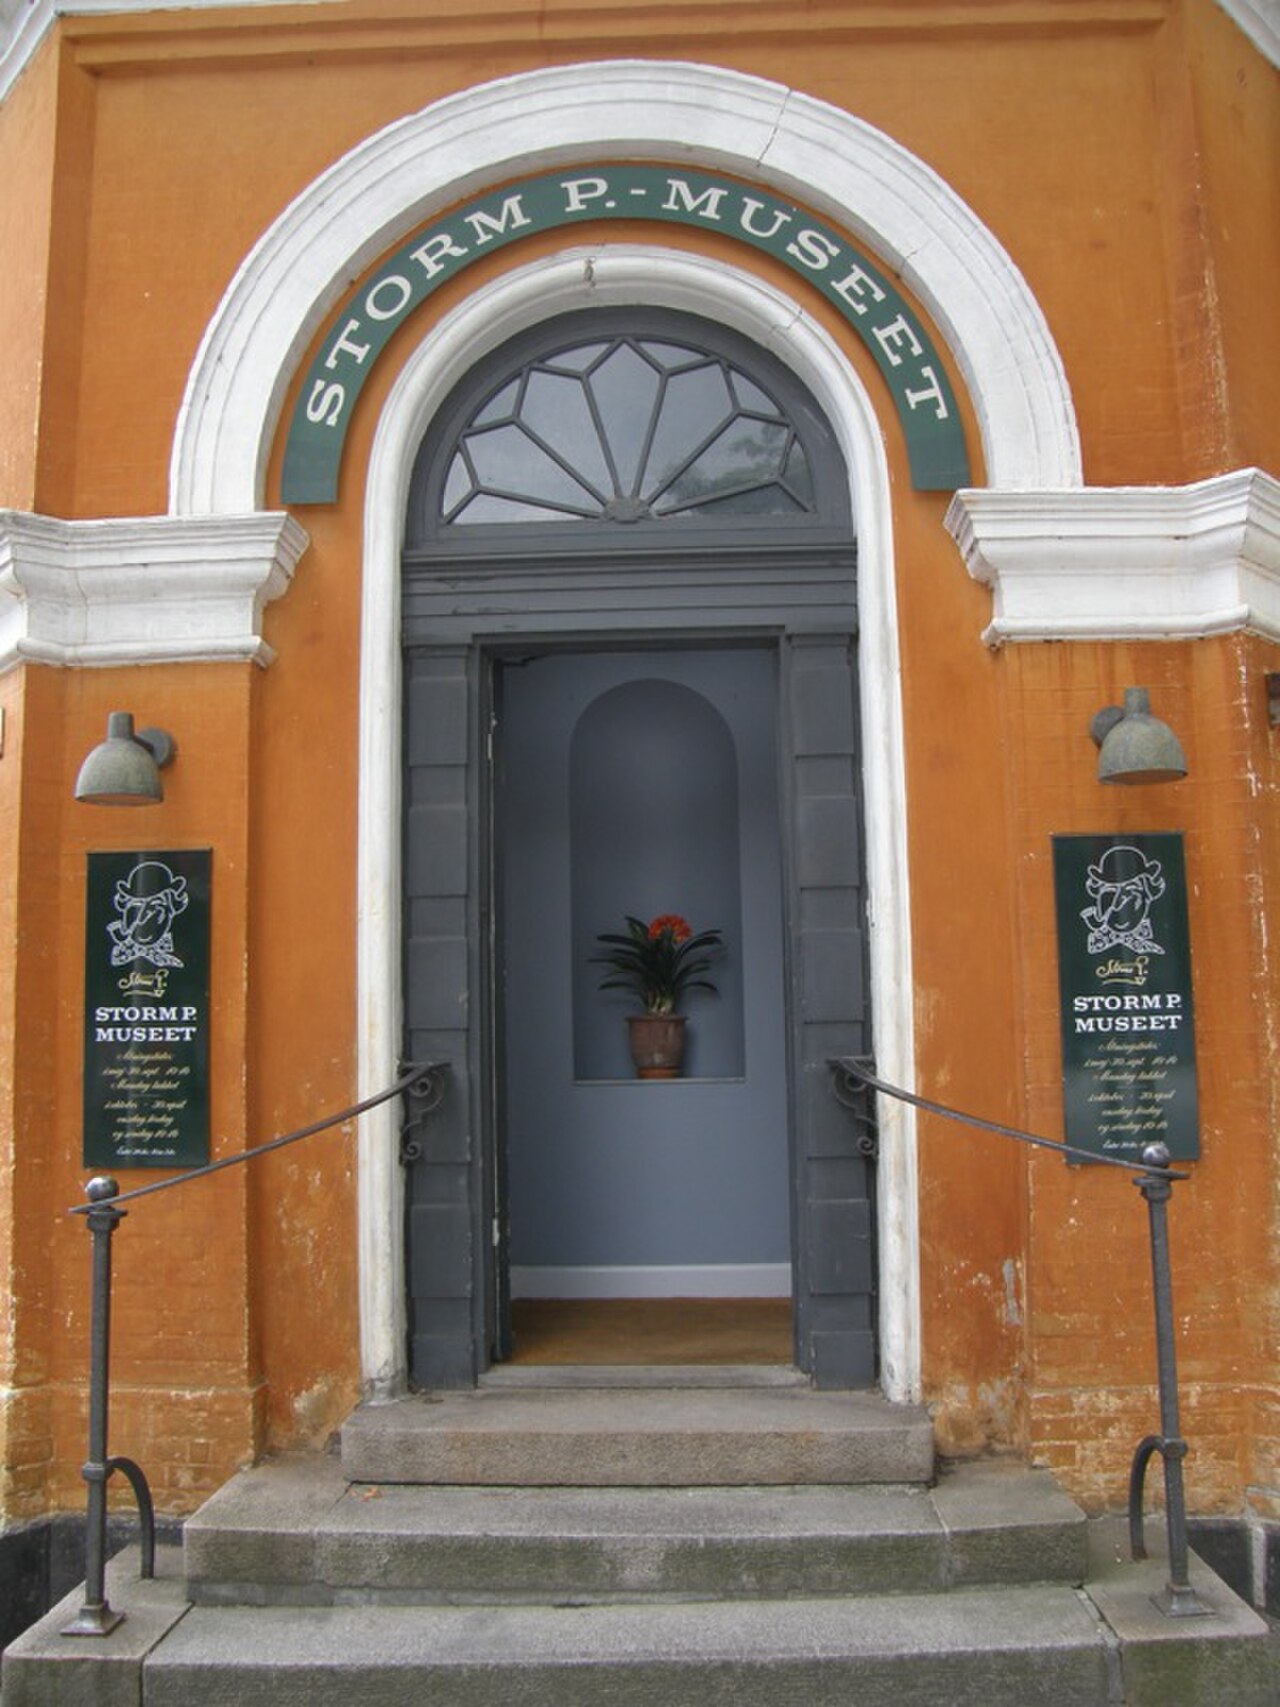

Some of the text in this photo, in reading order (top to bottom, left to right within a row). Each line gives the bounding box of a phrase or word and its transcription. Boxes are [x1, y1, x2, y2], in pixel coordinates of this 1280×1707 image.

[306, 195, 531, 427] STORM
[1073, 993, 1182, 1012] STORM P.
[95, 1006, 197, 1021] STORM P.
[1074, 1015, 1183, 1033] MUSEET
[95, 1027, 197, 1042] MUSEET
